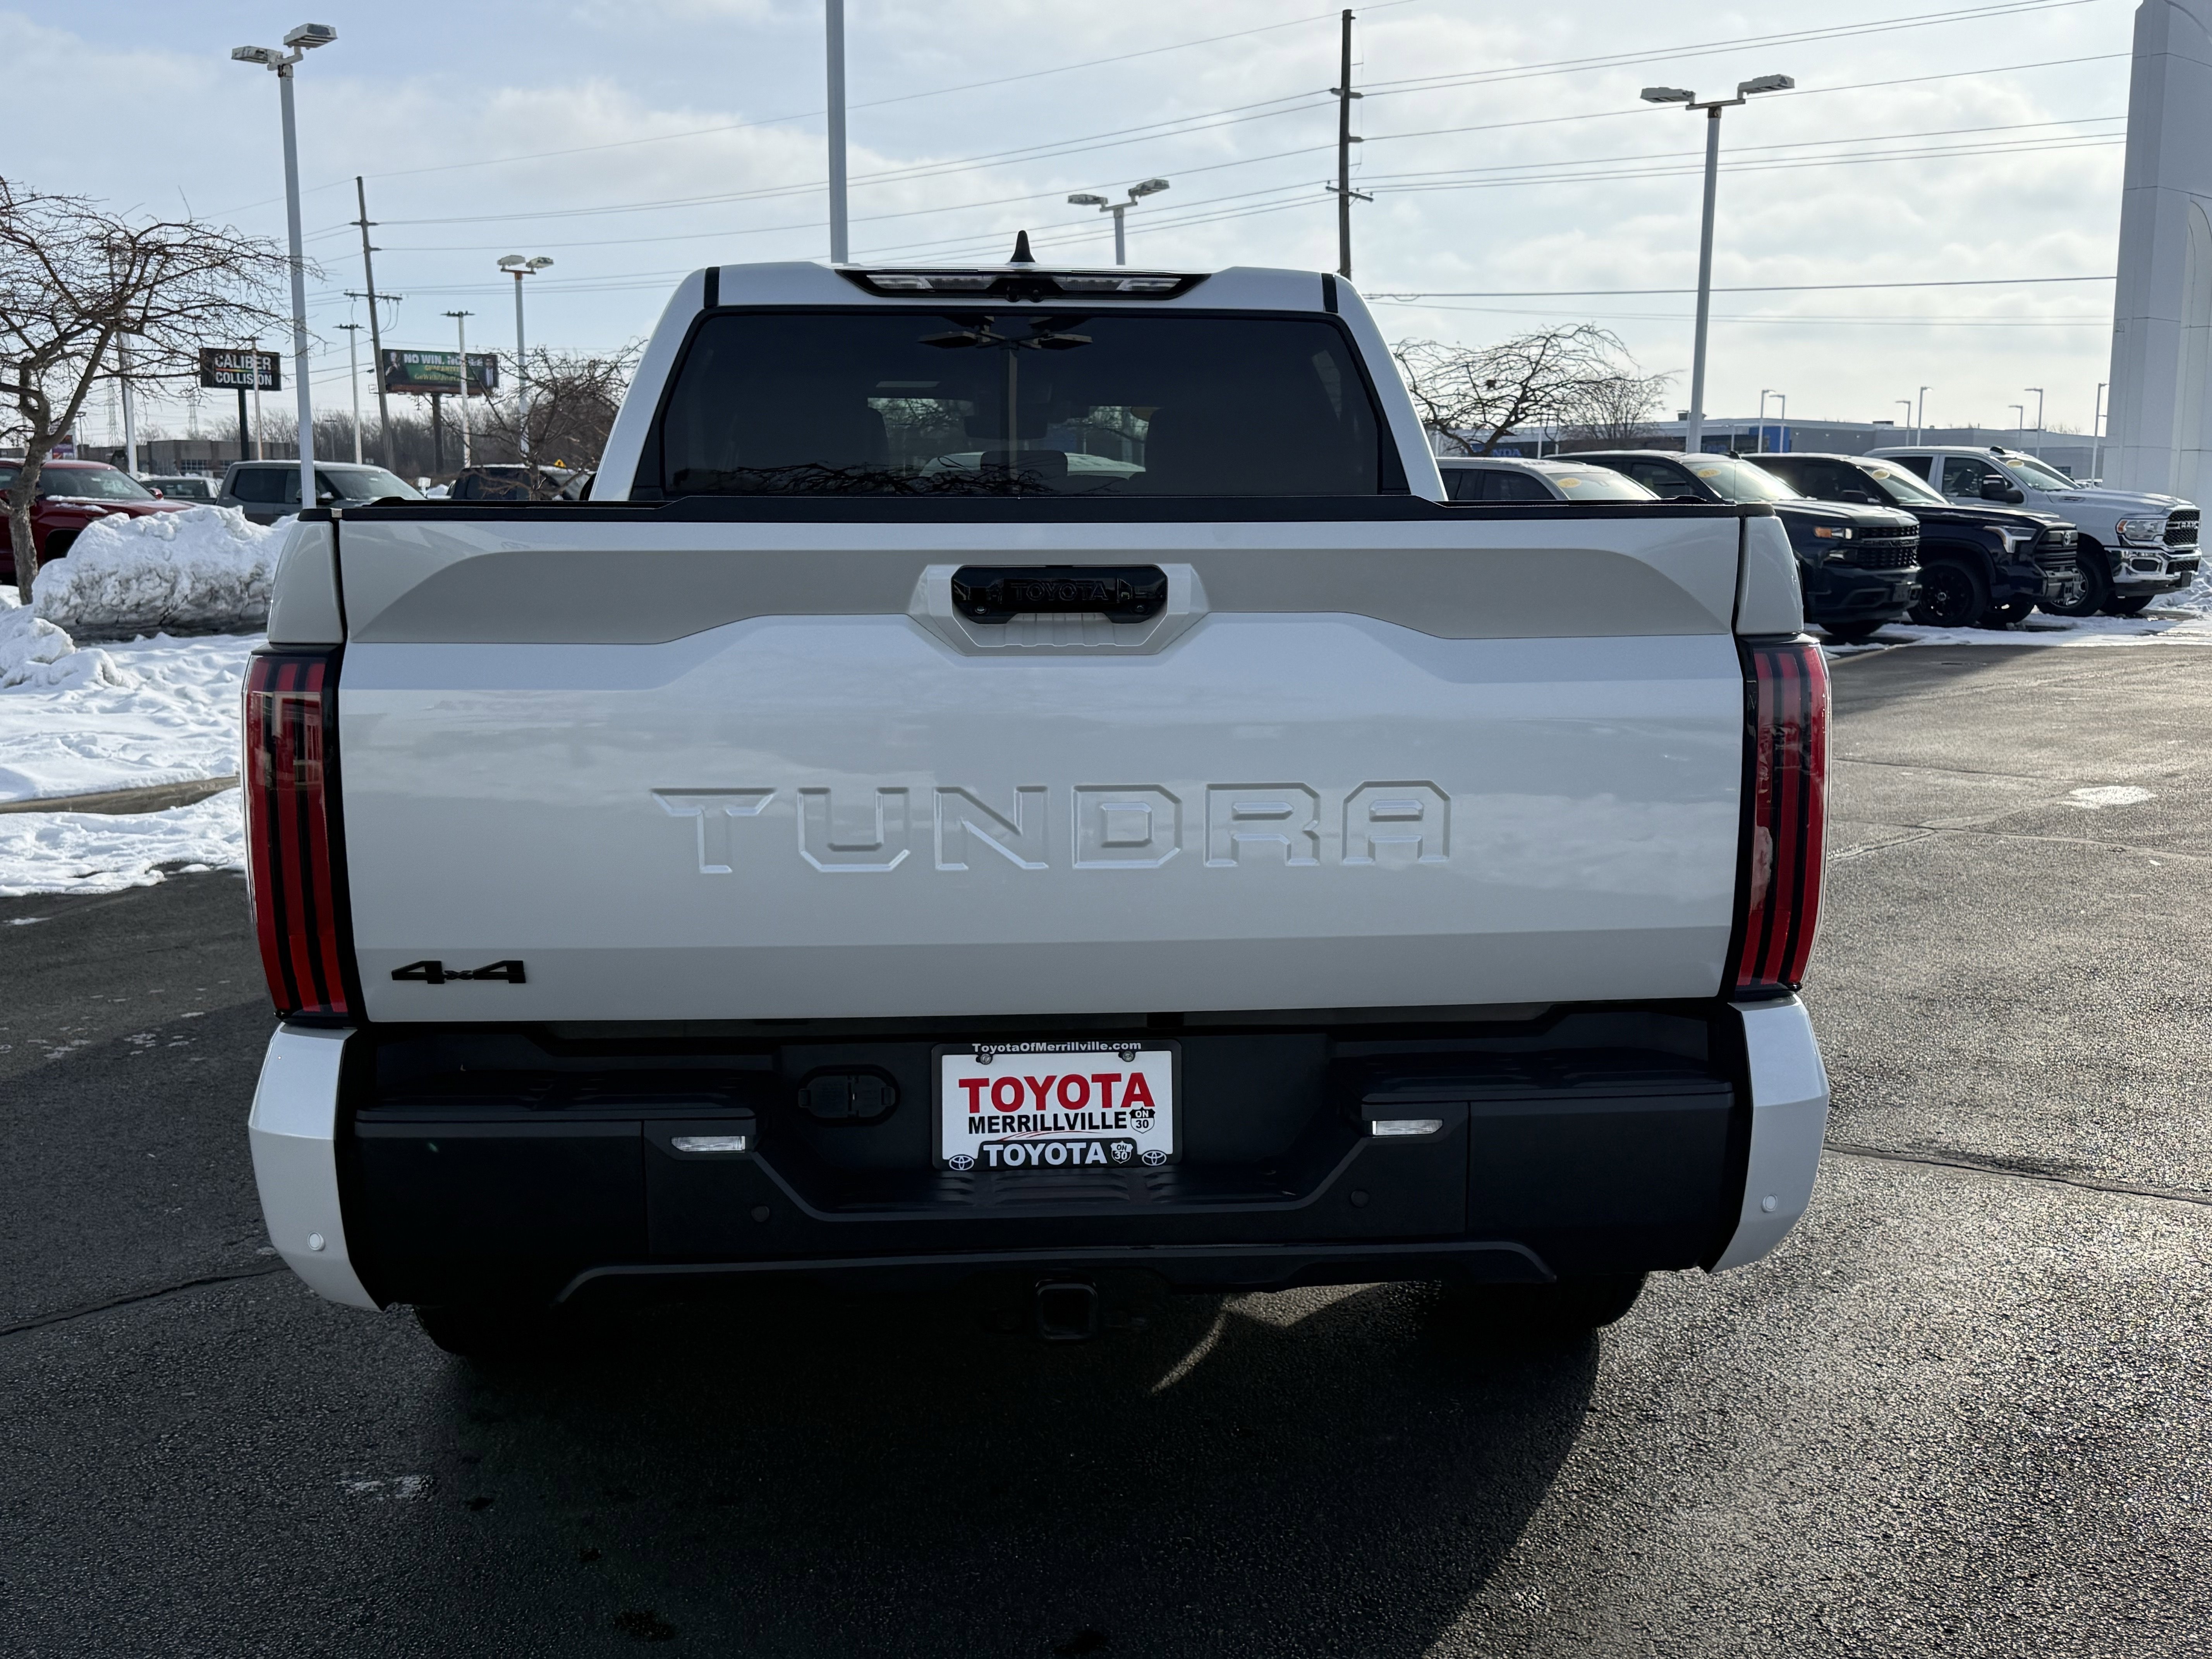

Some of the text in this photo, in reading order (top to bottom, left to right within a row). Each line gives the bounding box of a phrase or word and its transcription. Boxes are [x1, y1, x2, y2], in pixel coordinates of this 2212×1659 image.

[215, 354, 271, 370] CALIBER
[404, 354, 419, 363] NO
[422, 354, 444, 365] WIN.
[216, 371, 272, 386] COLLISON
[1010, 580, 1108, 601] TOYOTA
[651, 780, 1451, 874] TUNDRA
[972, 1041, 1141, 1054] ToyotaOfMerrillville.com
[958, 1072, 1155, 1113] TOYOTA
[968, 1111, 1127, 1134] MERRILLVILLE
[1135, 1119, 1149, 1128] 30
[983, 1142, 1108, 1167] TOYOTA
[1114, 1151, 1128, 1160] 30
